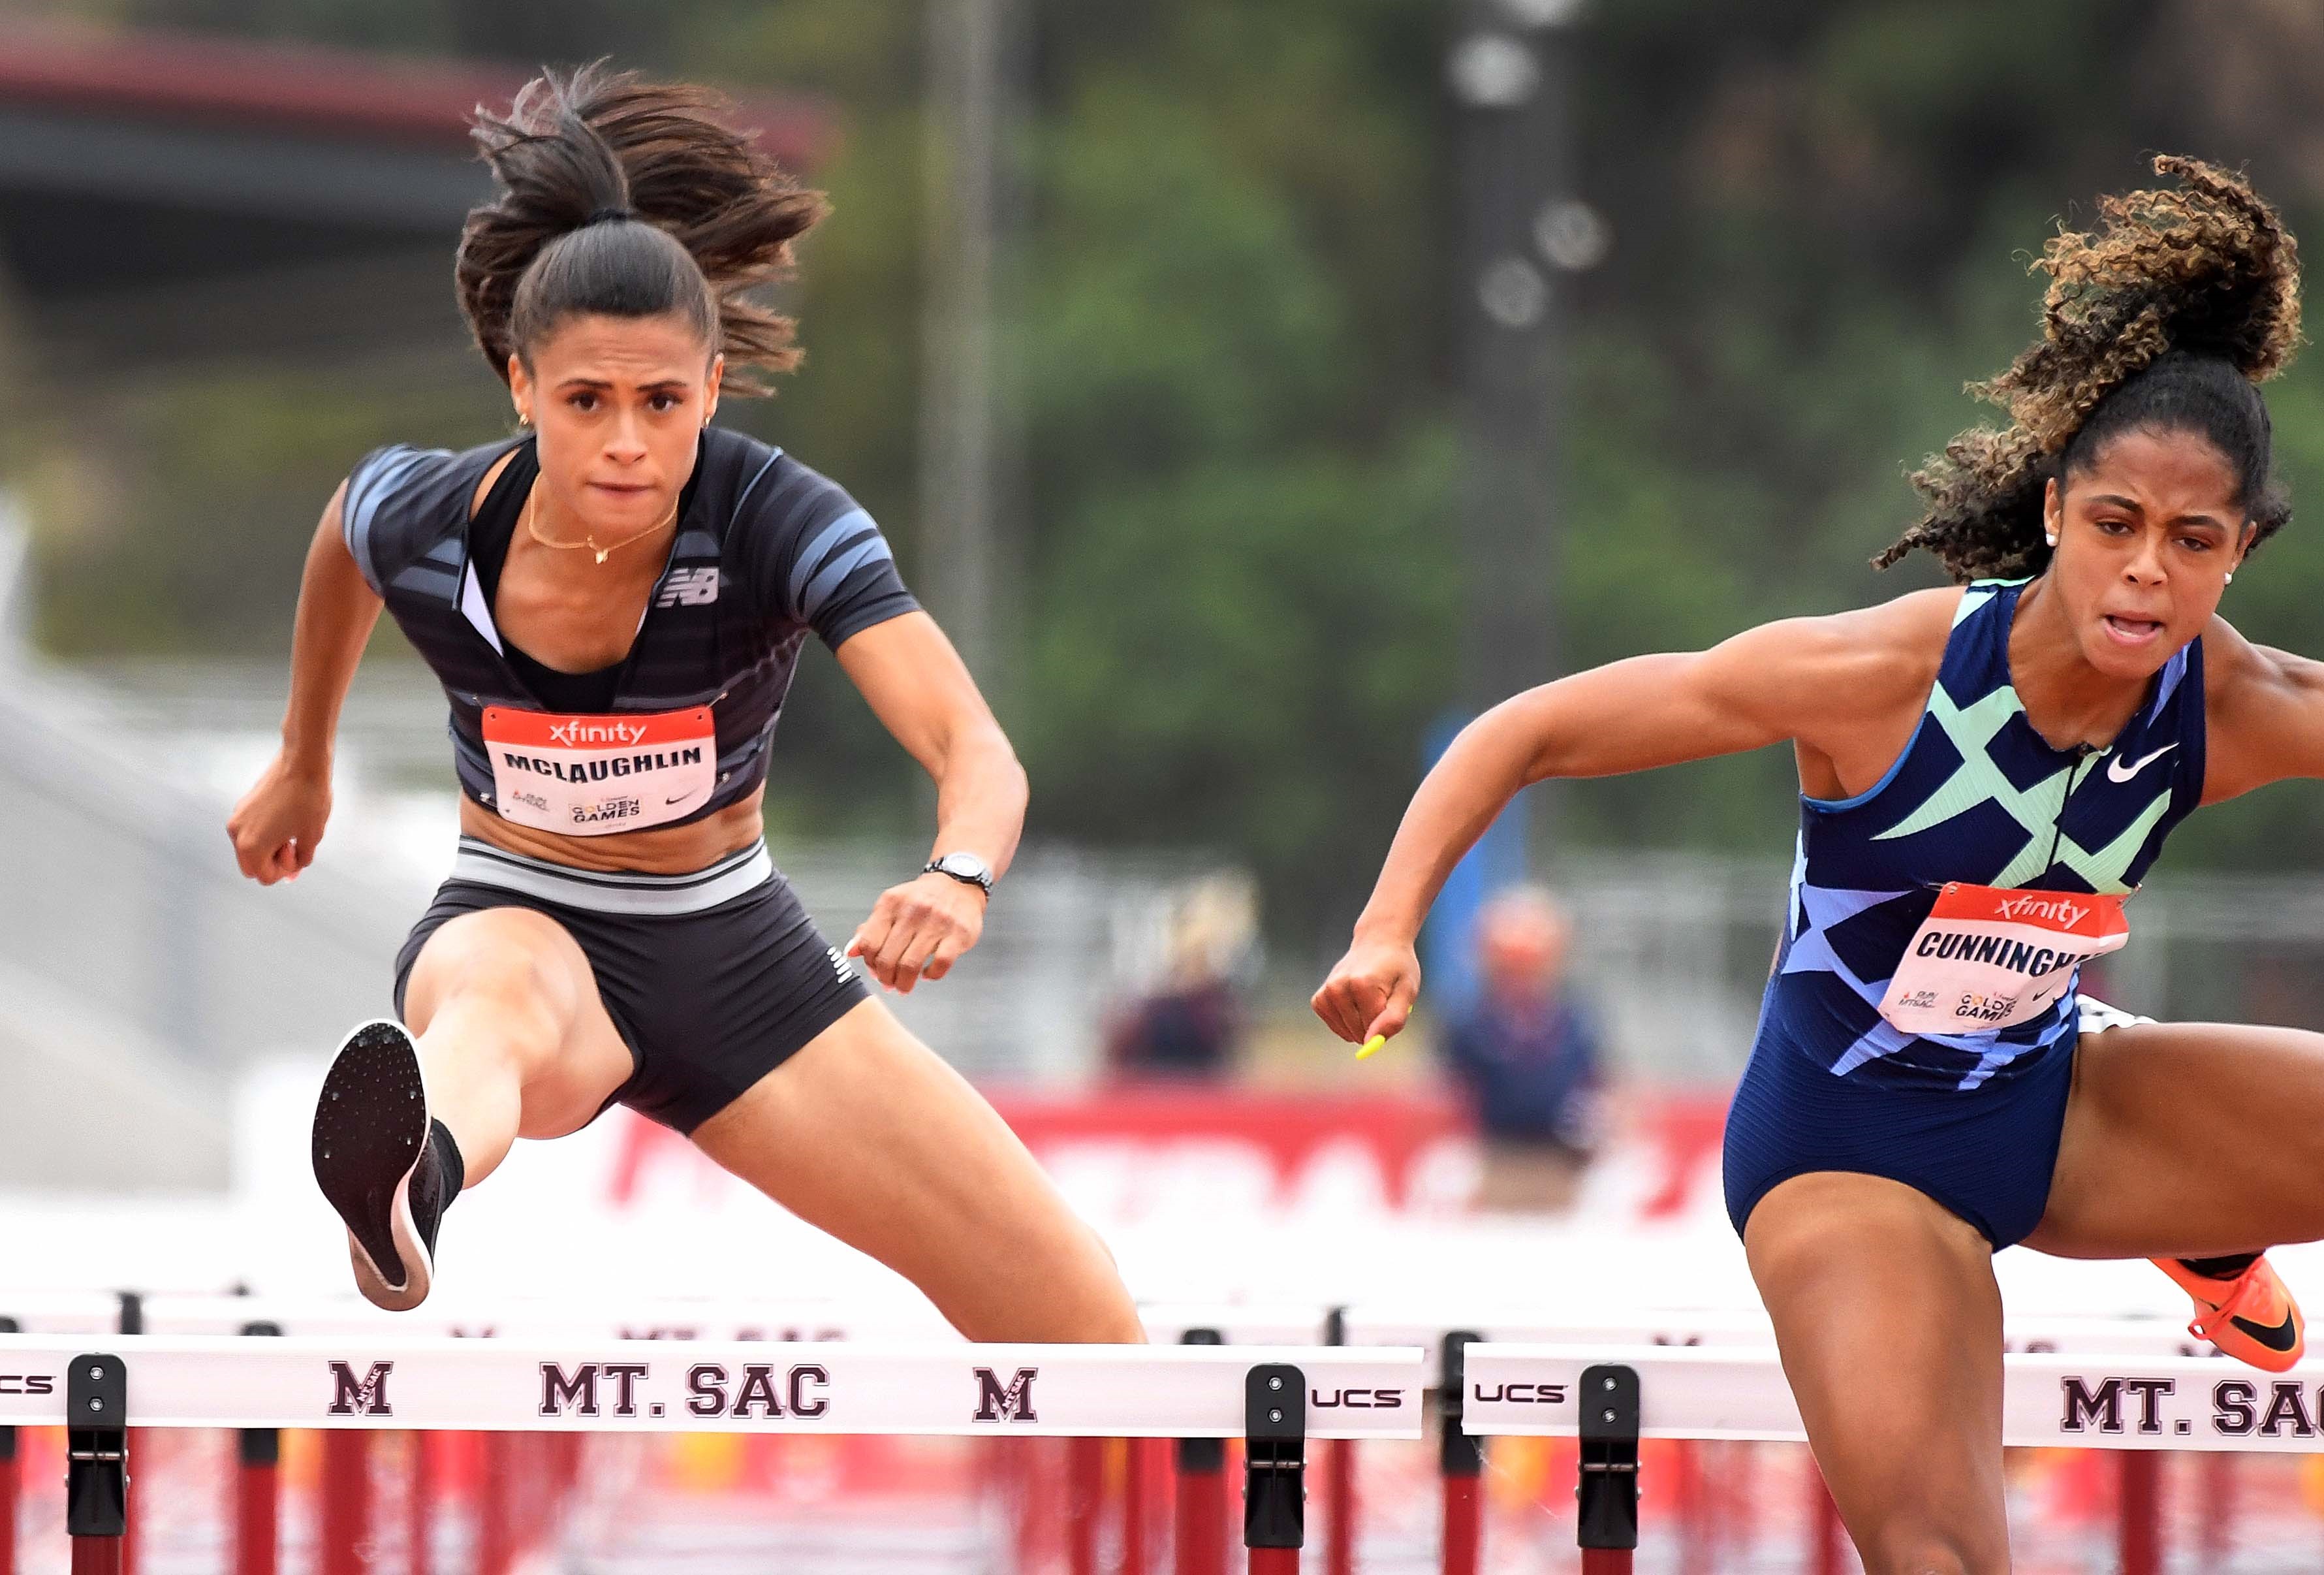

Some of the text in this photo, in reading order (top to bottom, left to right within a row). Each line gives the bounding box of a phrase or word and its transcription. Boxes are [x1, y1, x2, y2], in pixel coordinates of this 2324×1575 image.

[549, 720, 648, 747] xfinity
[503, 746, 702, 784] MCLAUGHLIN
[572, 799, 640, 814] GOLDEN
[574, 806, 640, 824] GAMES
[1994, 893, 2090, 930] xfinity
[1916, 931, 2103, 978] CUNNINGH
[328, 1361, 394, 1416] M
[539, 1361, 830, 1420] MT. SAC
[972, 1367, 1039, 1423] M
[1311, 1389, 1404, 1408] UCS
[1475, 1384, 1566, 1403] UCS
[2060, 1375, 2324, 1438] MT. SA
